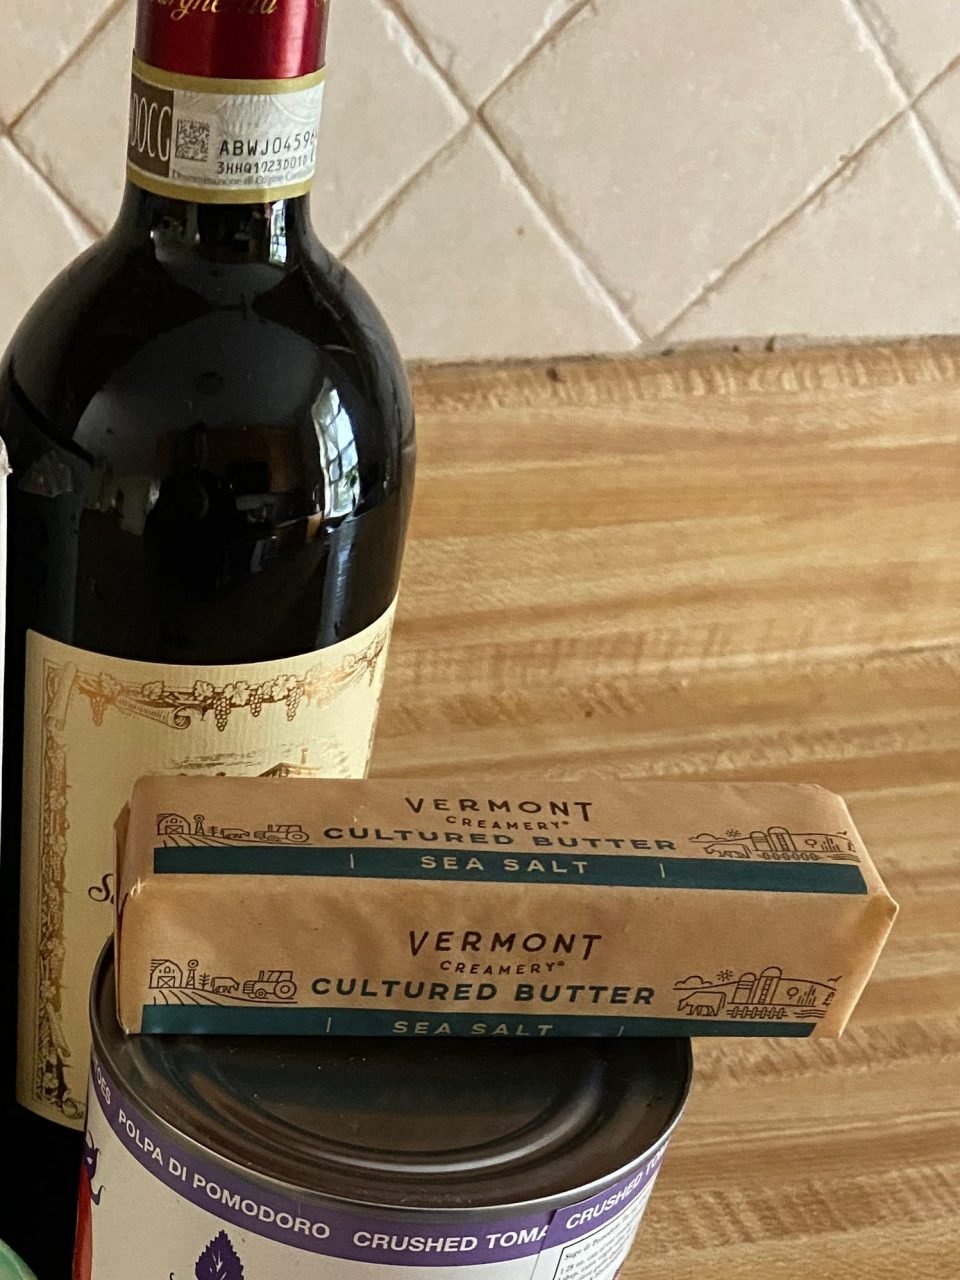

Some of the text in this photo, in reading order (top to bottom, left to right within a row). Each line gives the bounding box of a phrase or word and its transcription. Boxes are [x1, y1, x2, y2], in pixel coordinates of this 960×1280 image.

[405, 797, 592, 822] VERMONT
[323, 827, 677, 850] CULTURED BUTTER
[421, 856, 588, 874] SEA SALT
[409, 931, 602, 961] VERMONT
[311, 977, 656, 1006] CULTURED BUTTER
[393, 1020, 555, 1037] SEA SALT
[118, 1109, 330, 1239] POLPA DI POMODORO
[566, 1172, 643, 1230] CRUSHED
[353, 1231, 477, 1253] CRUSHED
